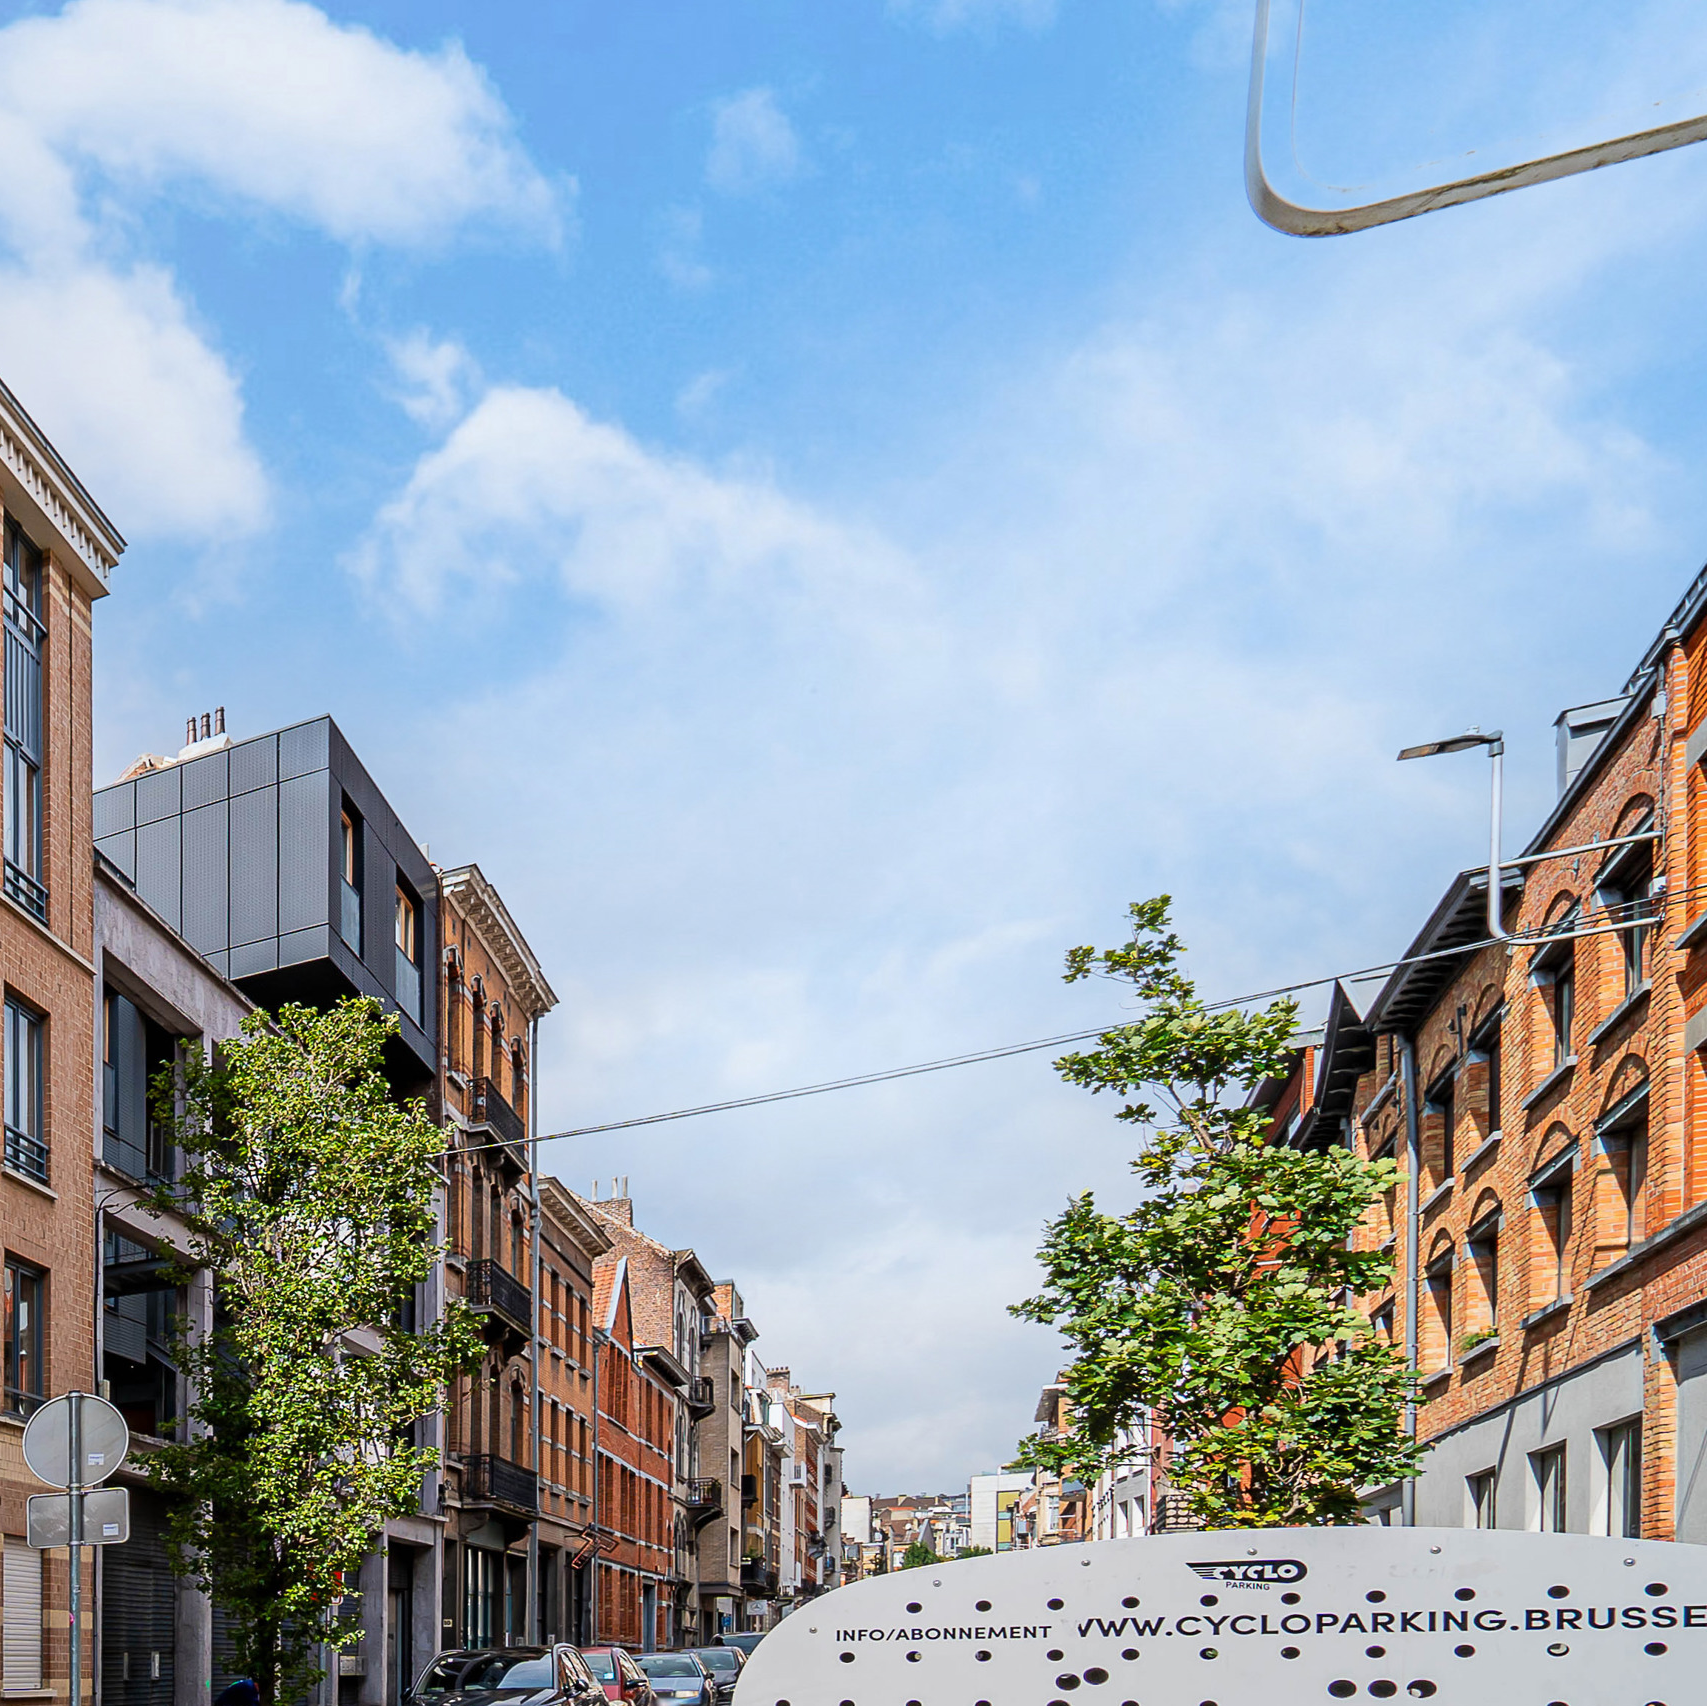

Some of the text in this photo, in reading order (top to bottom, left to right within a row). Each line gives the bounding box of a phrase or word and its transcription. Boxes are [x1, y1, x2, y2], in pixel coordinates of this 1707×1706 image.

[1211, 1564, 1299, 1579] CYCLO
[1225, 1581, 1271, 1591] PARKING
[835, 1625, 1053, 1642] INFO/ABONNEMENT
